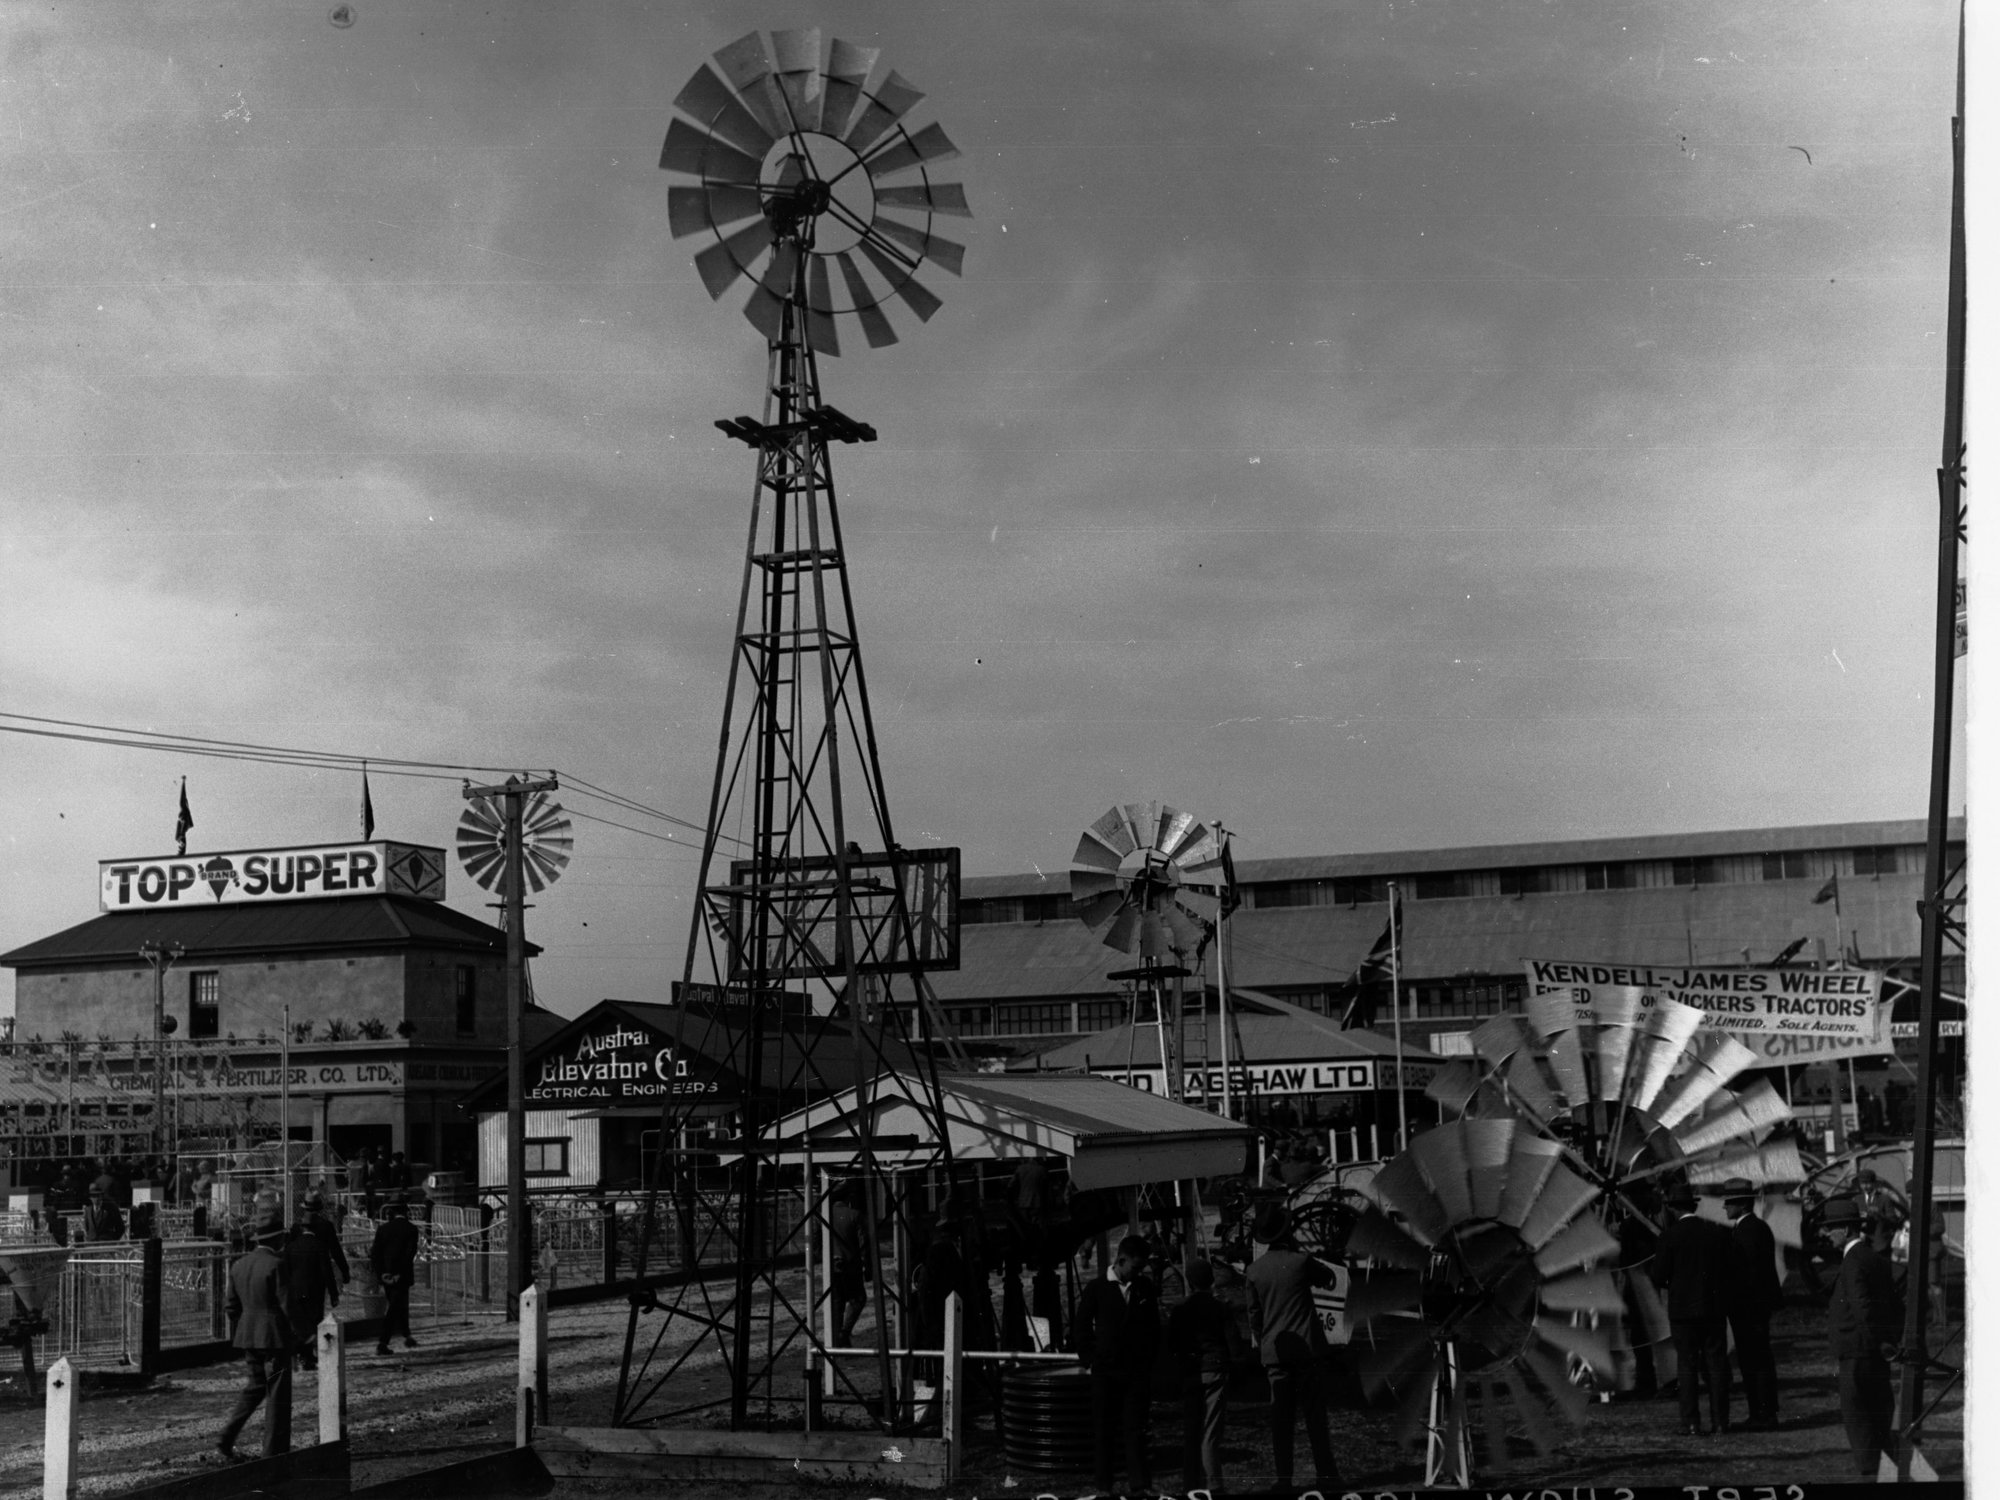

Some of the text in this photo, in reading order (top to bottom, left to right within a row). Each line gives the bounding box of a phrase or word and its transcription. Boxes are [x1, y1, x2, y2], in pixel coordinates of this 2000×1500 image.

[111, 864, 195, 904] TOP
[243, 851, 377, 895] SUPER
[1533, 961, 1872, 994] KENDELL-JAMES WHEEL
[1777, 1018, 1810, 1031] SOLE
[320, 1066, 346, 1083] CO.
[537, 1053, 649, 1087] Elevator
[1187, 1066, 1374, 1092] AGSHAW LTD.
[525, 1085, 611, 1100] LECTRICAL
